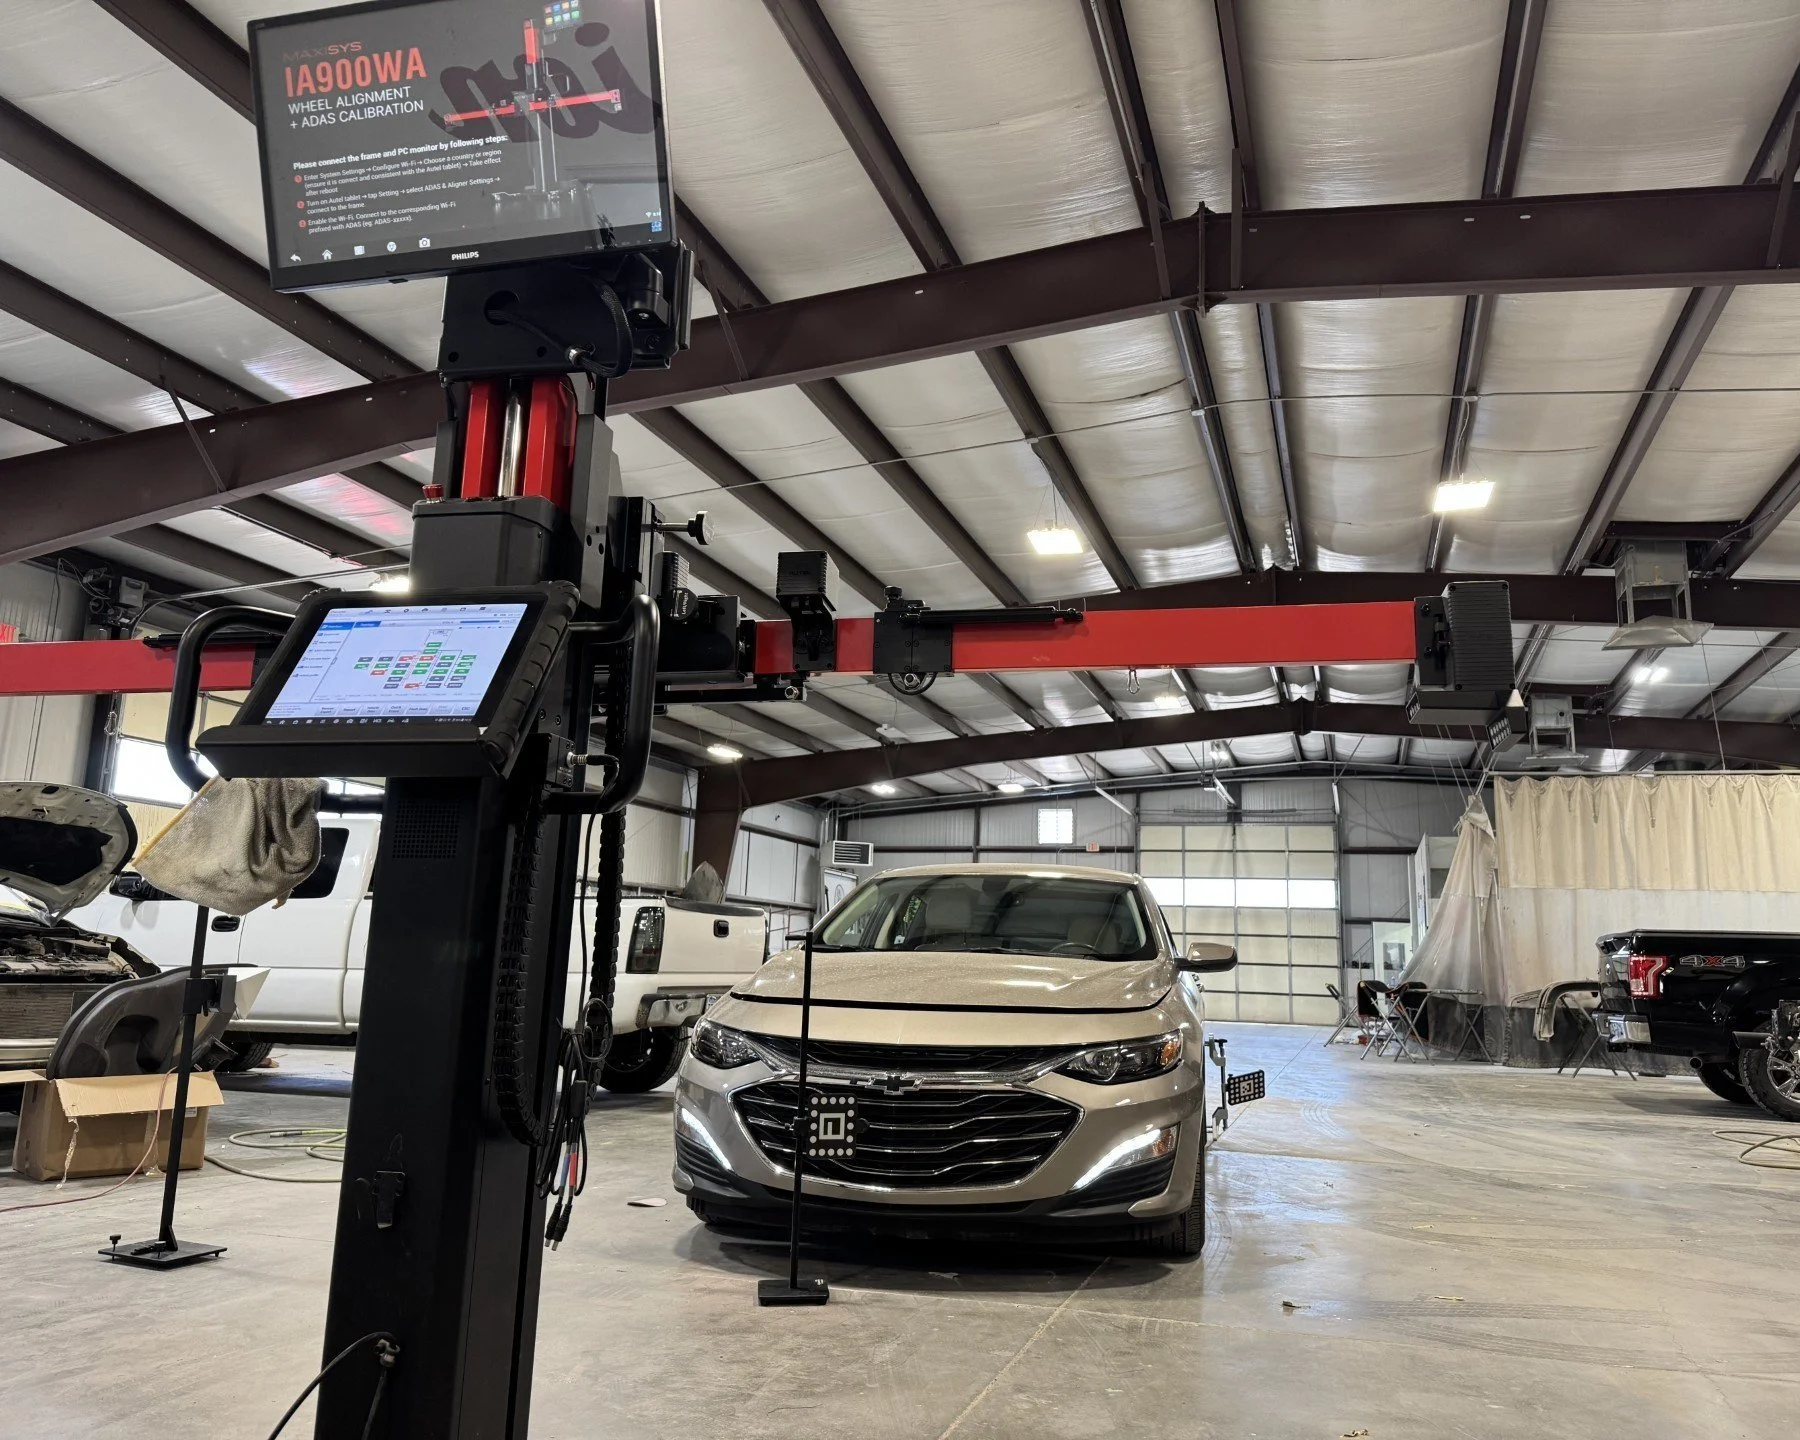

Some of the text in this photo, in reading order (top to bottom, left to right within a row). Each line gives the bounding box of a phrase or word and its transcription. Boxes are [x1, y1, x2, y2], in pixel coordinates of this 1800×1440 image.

[285, 47, 427, 98] IA900WA
[288, 85, 412, 115] WHEEL ALIGNMENT
[301, 113, 336, 128] ADAS
[339, 100, 424, 123] CALIBRATION
[318, 157, 346, 166] connect
[383, 149, 396, 157] and
[410, 144, 438, 153] monitor
[439, 142, 448, 150] by
[450, 138, 484, 148] following
[451, 251, 480, 261] PHILIPS
